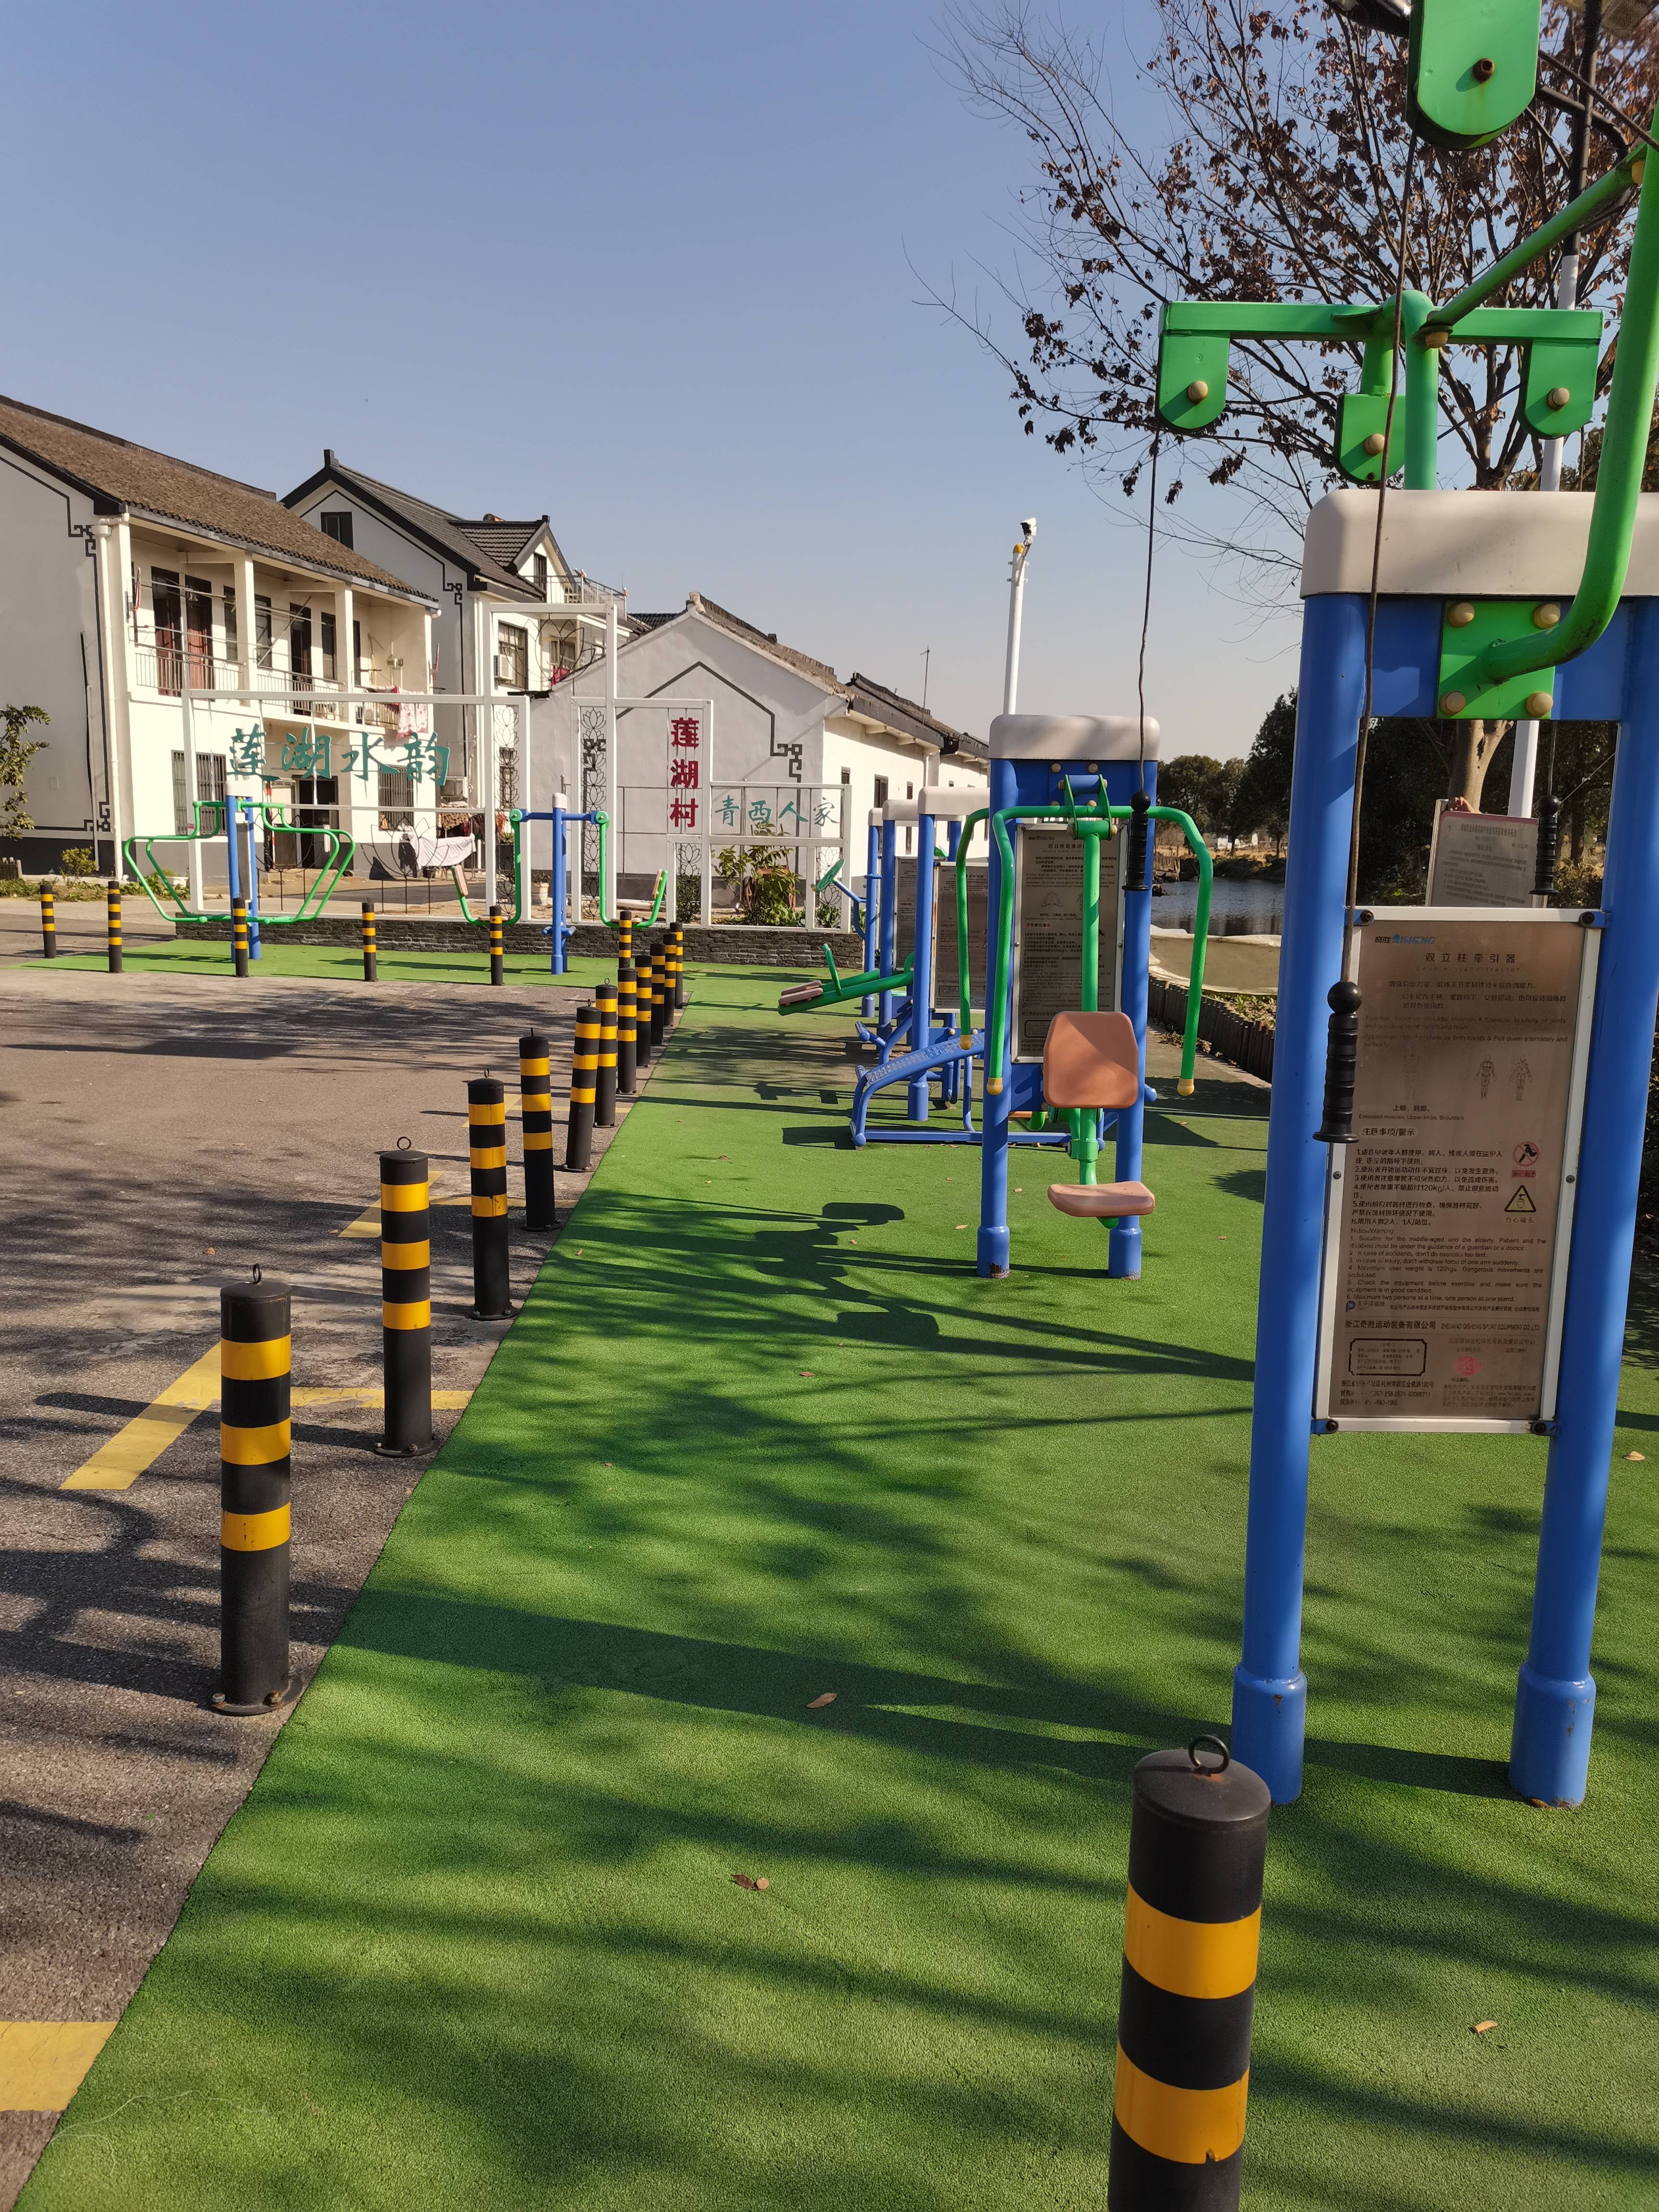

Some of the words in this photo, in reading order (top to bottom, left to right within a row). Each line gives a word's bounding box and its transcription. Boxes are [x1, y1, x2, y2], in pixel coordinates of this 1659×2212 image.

[227, 723, 450, 786] 莲湖水韵
[715, 795, 840, 827] 青西人家
[1424, 952, 1516, 963] 双立柱牵引器
[1345, 1320, 1436, 1330] 浙江奇胜运动装备有限公司
